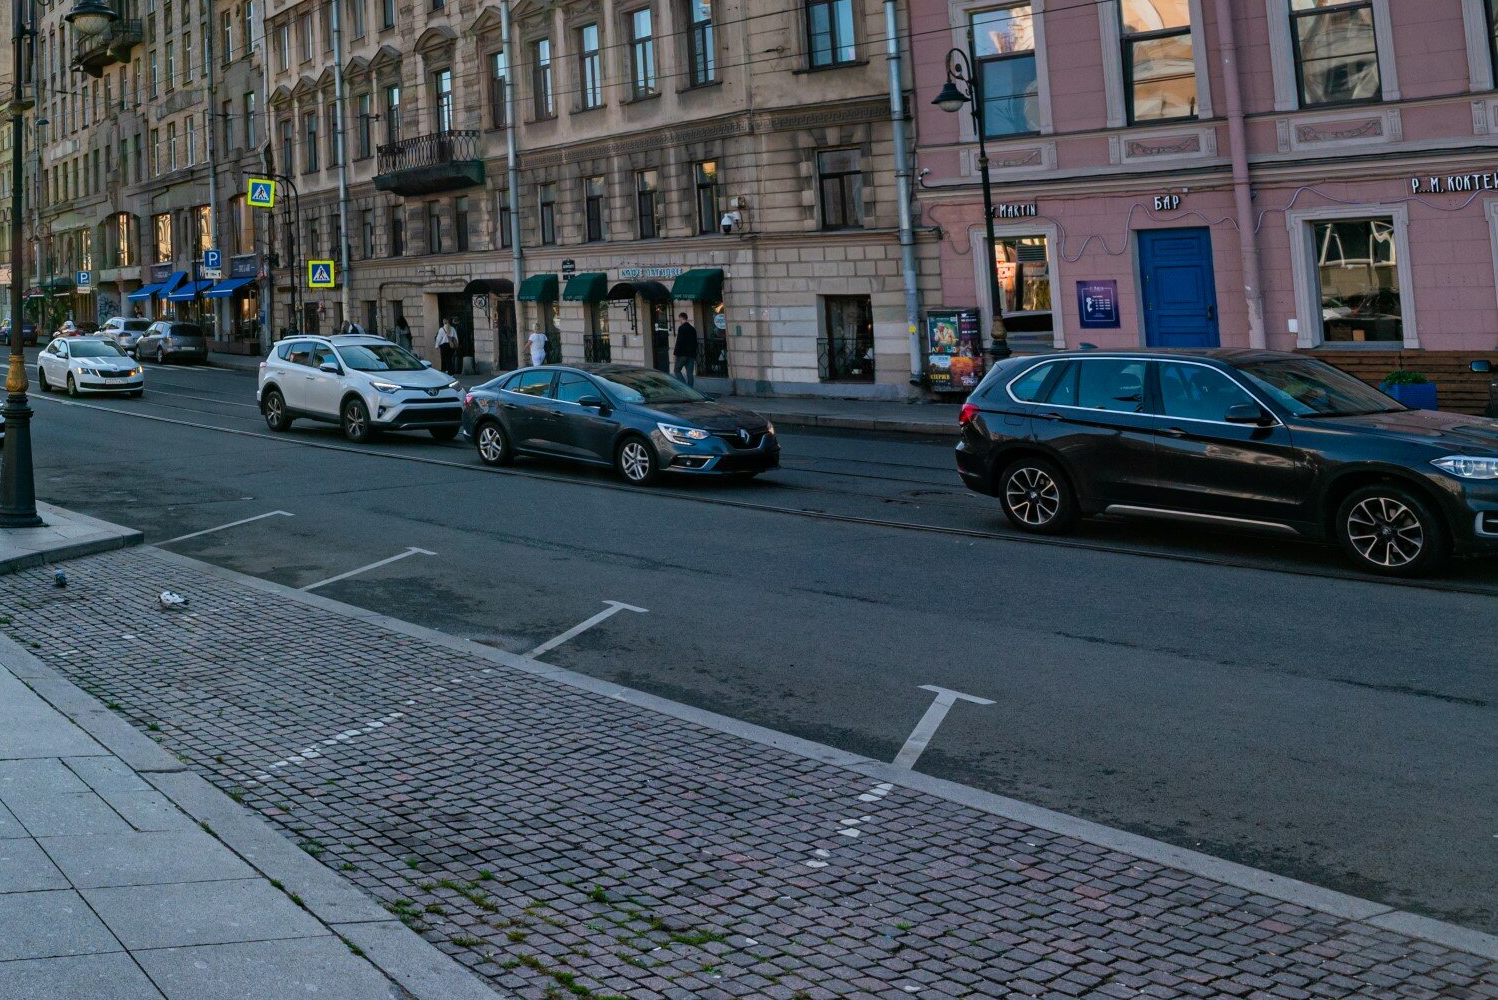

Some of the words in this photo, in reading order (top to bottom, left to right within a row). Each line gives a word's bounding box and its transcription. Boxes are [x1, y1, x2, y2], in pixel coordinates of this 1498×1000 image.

[1154, 195, 1181, 211] БАР
[999, 204, 1036, 218] MARTIN
[208, 252, 218, 266] P
